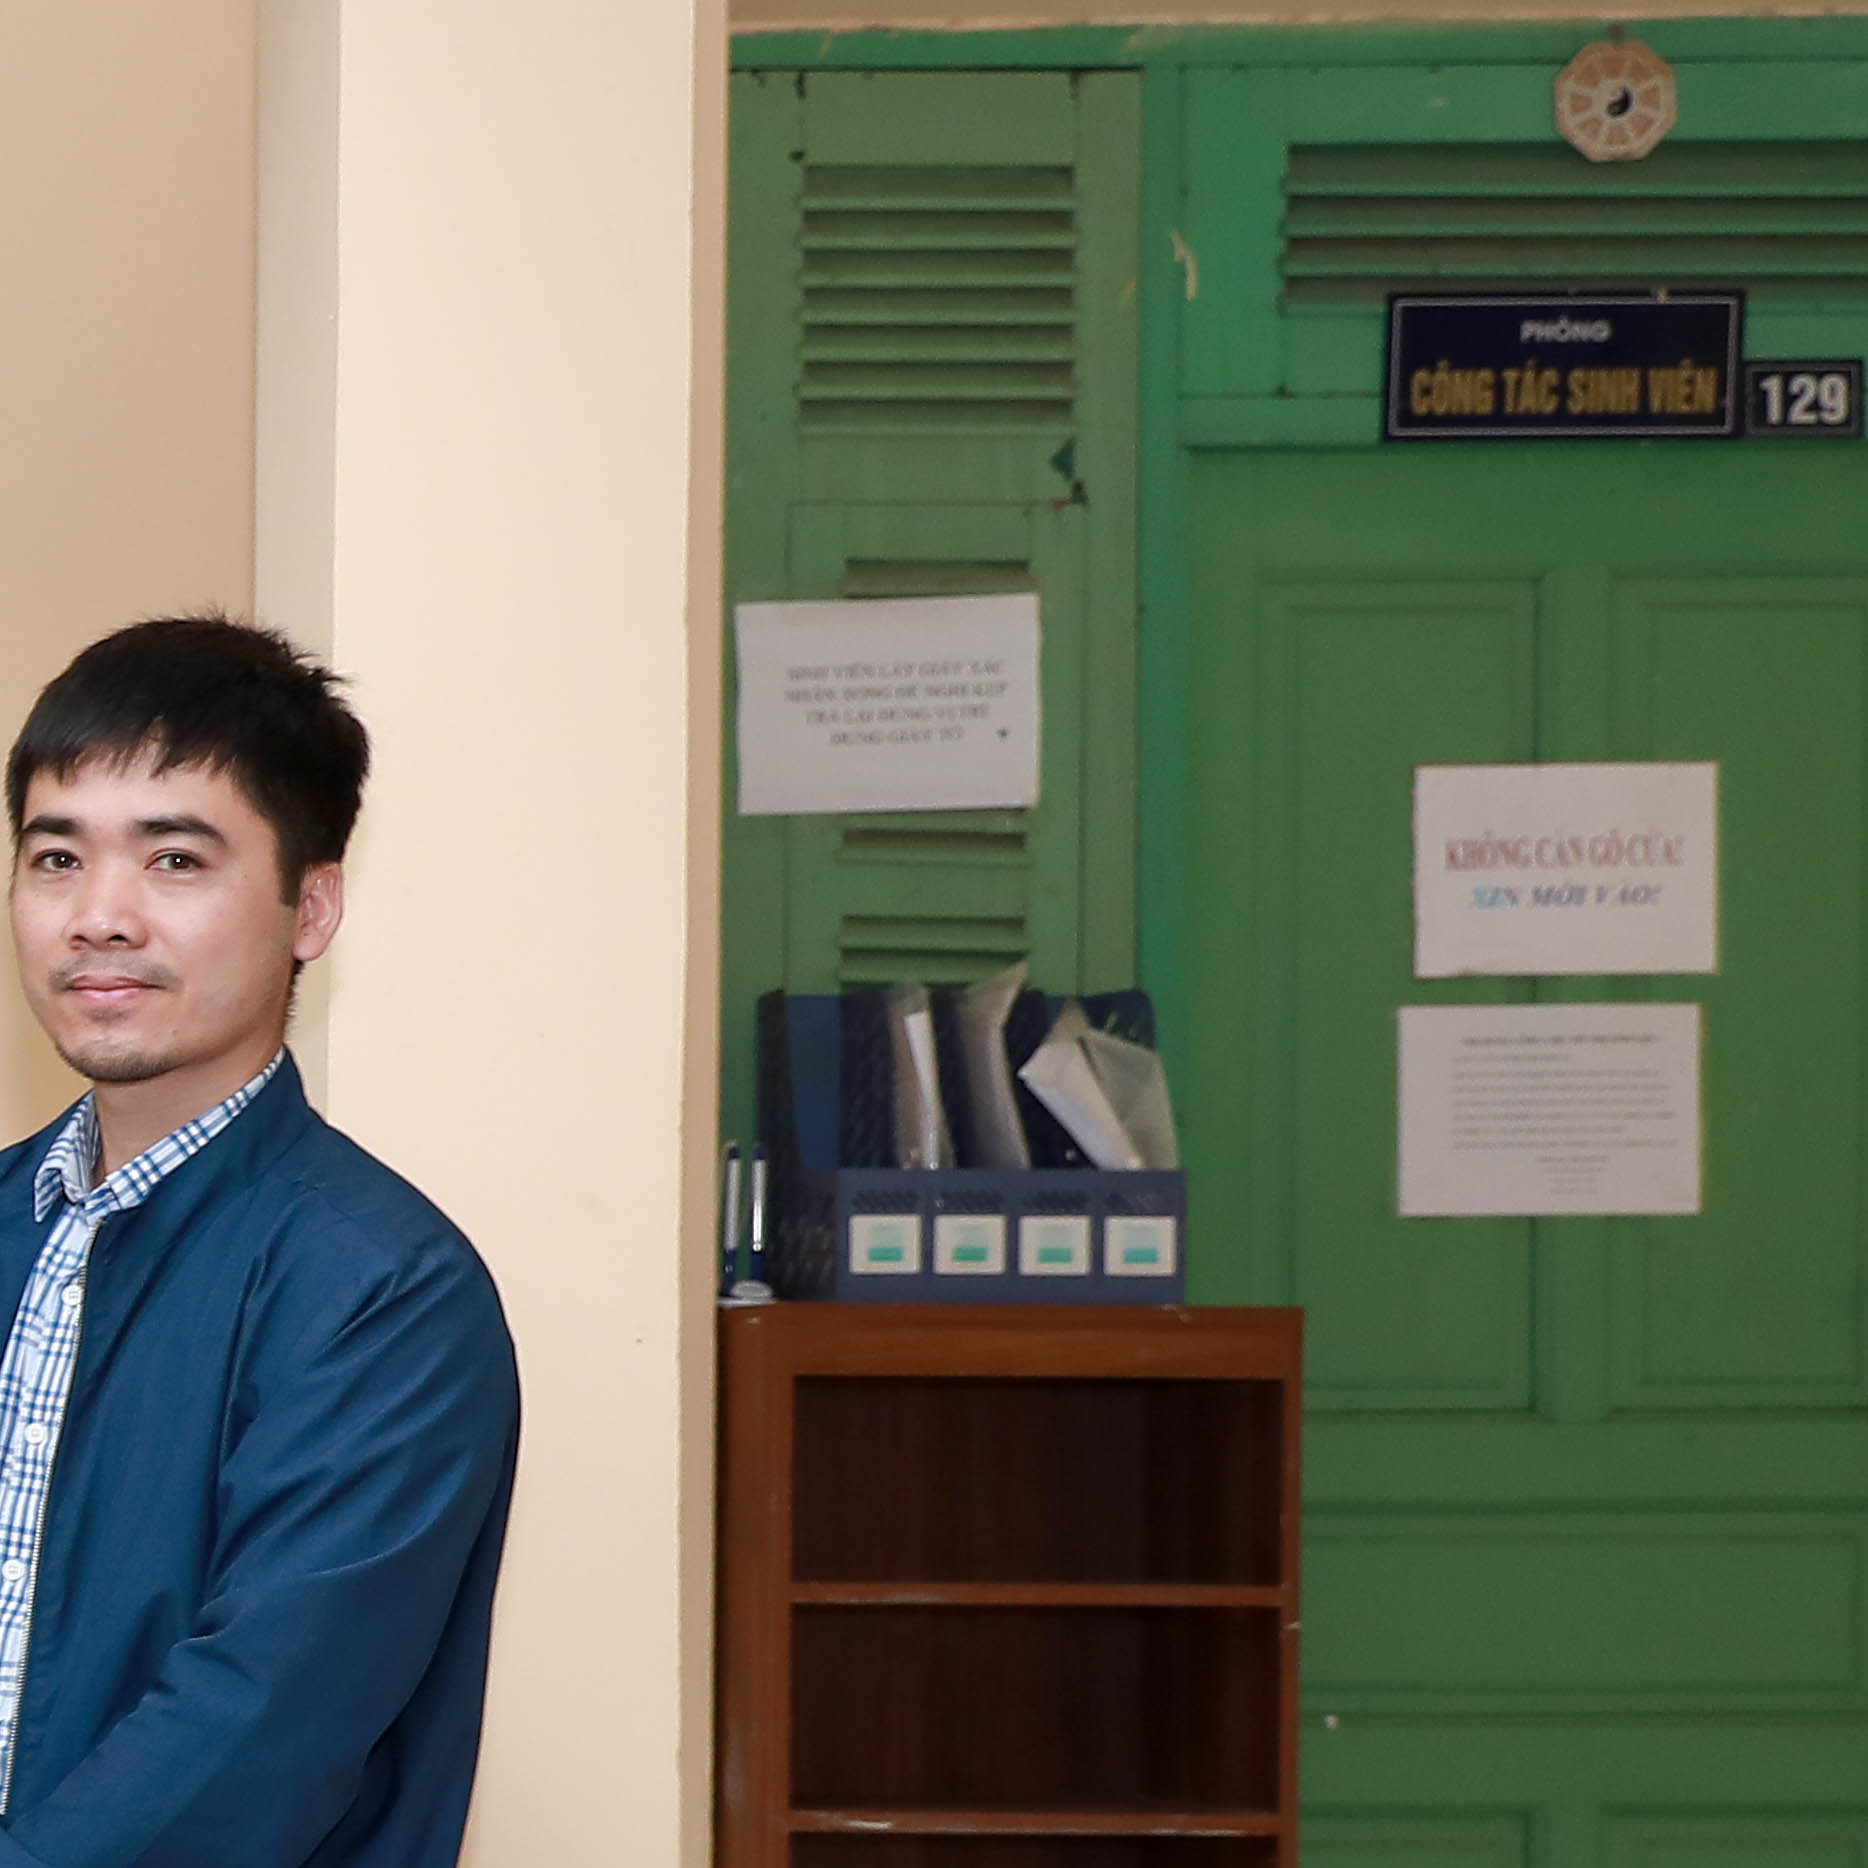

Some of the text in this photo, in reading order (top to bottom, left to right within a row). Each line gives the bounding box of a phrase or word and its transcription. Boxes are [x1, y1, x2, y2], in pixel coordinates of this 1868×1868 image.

[1521, 314, 1611, 343] PHÒNG
[1411, 357, 1716, 415] CÔNG TÁC SINH VIÊN
[1760, 373, 1848, 425] 129
